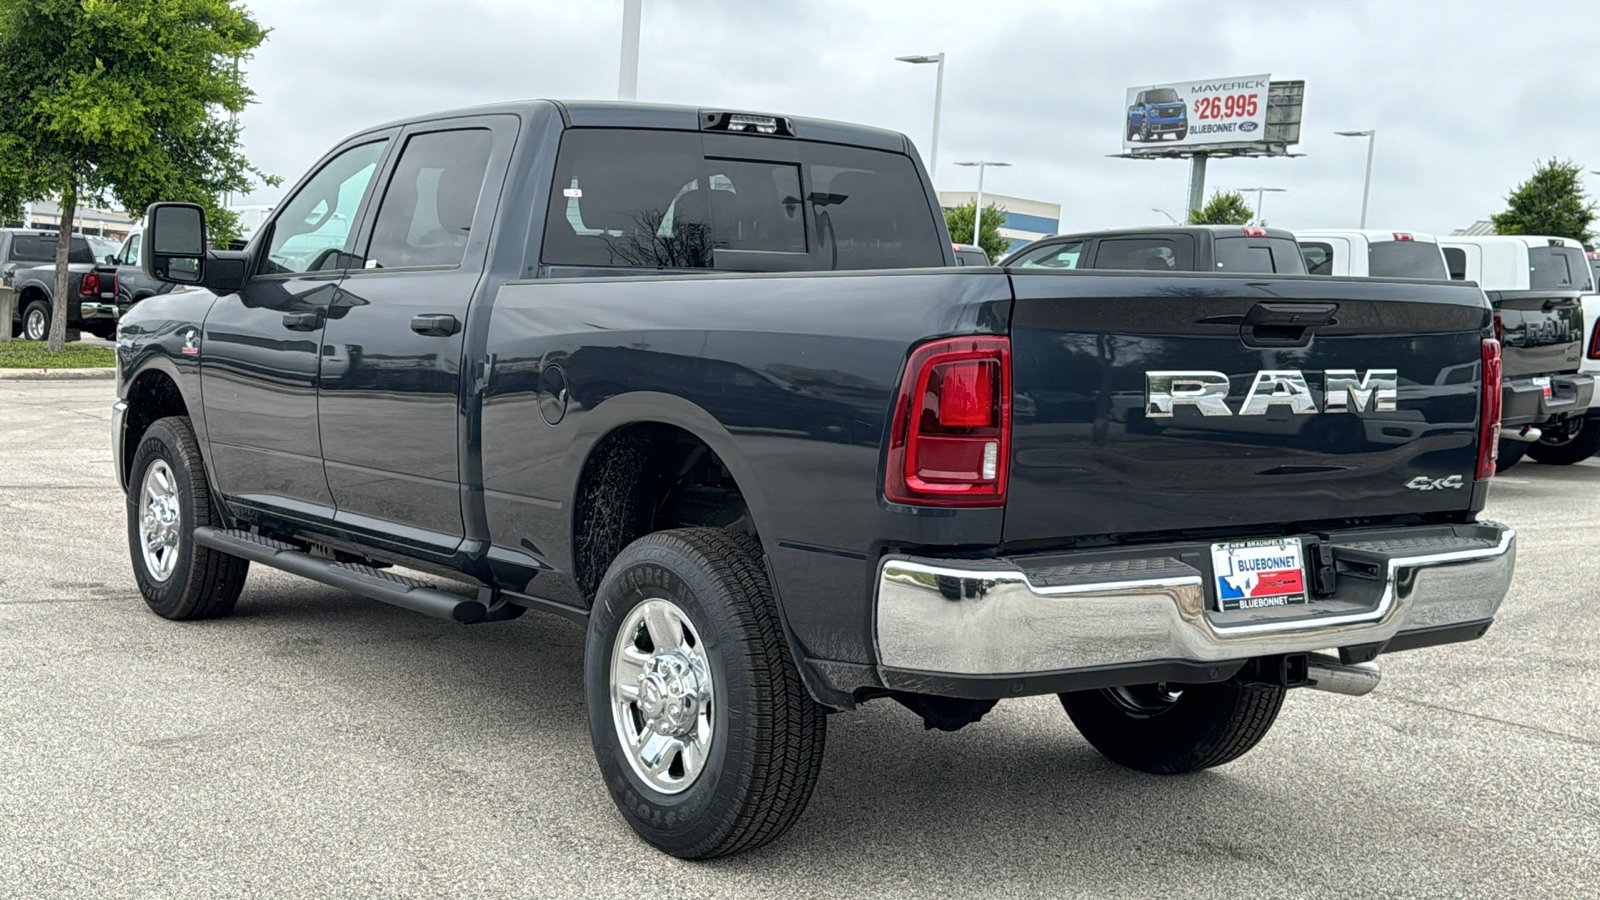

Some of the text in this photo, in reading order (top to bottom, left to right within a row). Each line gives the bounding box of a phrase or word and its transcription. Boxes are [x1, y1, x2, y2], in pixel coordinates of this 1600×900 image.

[1191, 80, 1265, 93] MAVERICK
[1194, 93, 1258, 121] $26,995
[1190, 122, 1237, 135] BLUEBONNET
[1525, 319, 1570, 341] RAM
[1145, 369, 1398, 418] RAM
[1238, 556, 1295, 572] BLUEBONNET
[1239, 596, 1288, 609] BLUEBONNET
